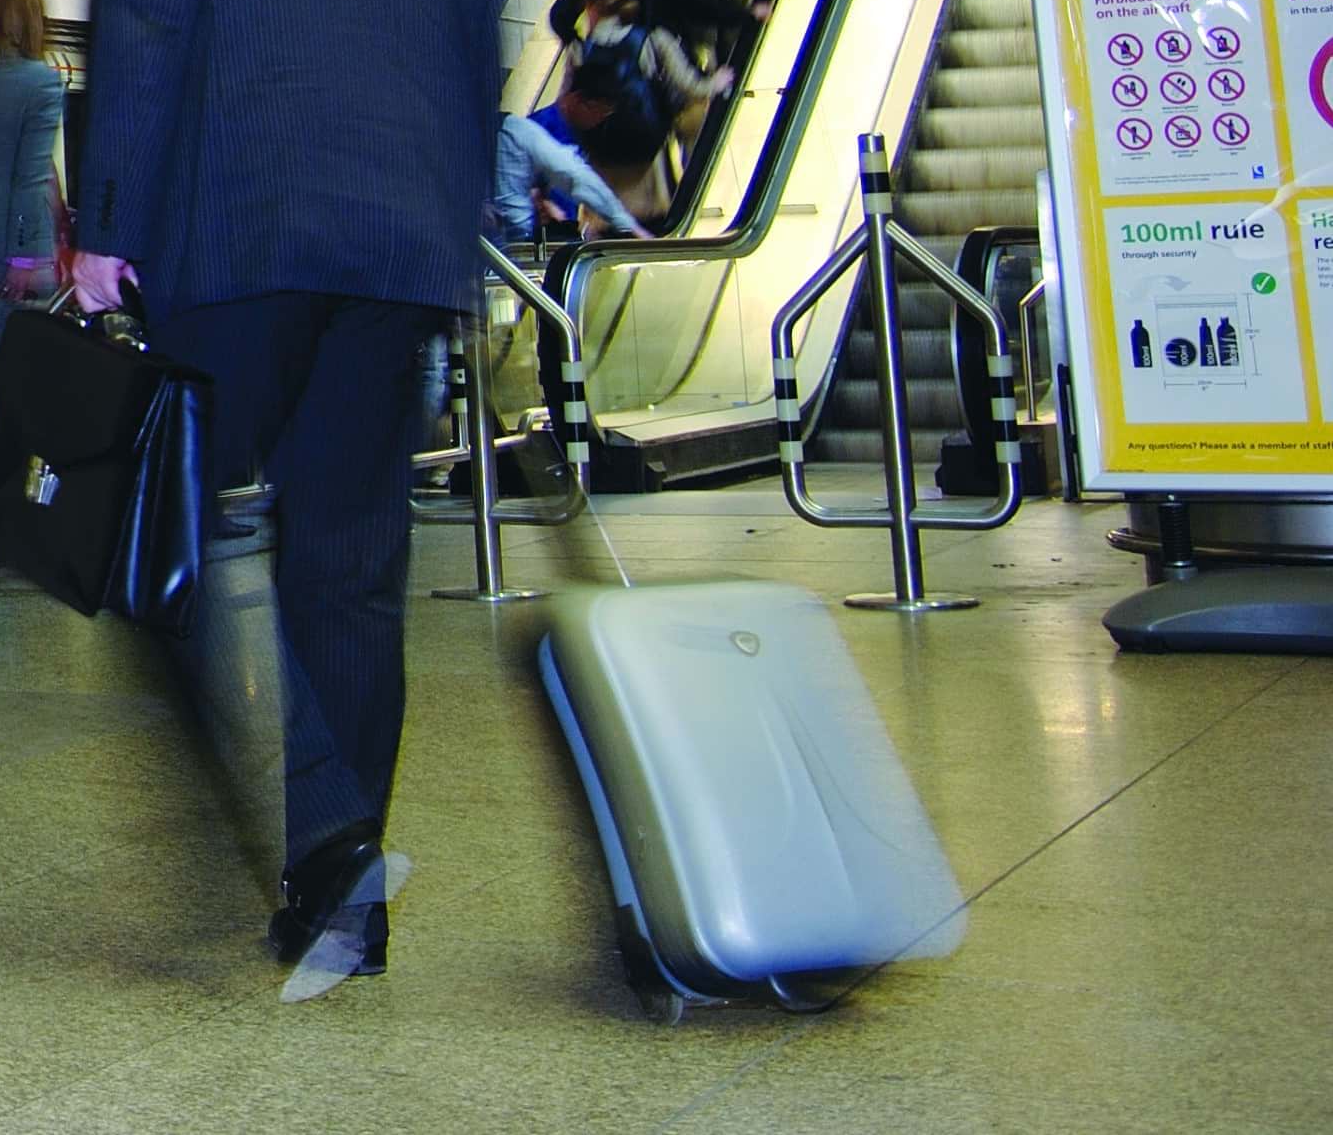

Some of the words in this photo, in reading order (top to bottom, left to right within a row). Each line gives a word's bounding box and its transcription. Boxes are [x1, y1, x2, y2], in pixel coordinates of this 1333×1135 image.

[1096, 9, 1113, 19] on
[1117, 7, 1139, 18] the
[1142, 3, 1191, 16] airraft
[1301, 5, 1318, 14] the
[1121, 221, 1202, 243] 100ml
[1121, 249, 1159, 260] through
[1161, 249, 1197, 259] security
[1128, 442, 1145, 451] Any
[1148, 441, 1197, 451] questions?
[1199, 441, 1229, 450] Please
[1231, 440, 1246, 450] ask
[1258, 440, 1297, 450] member
[1300, 440, 1310, 450] of
